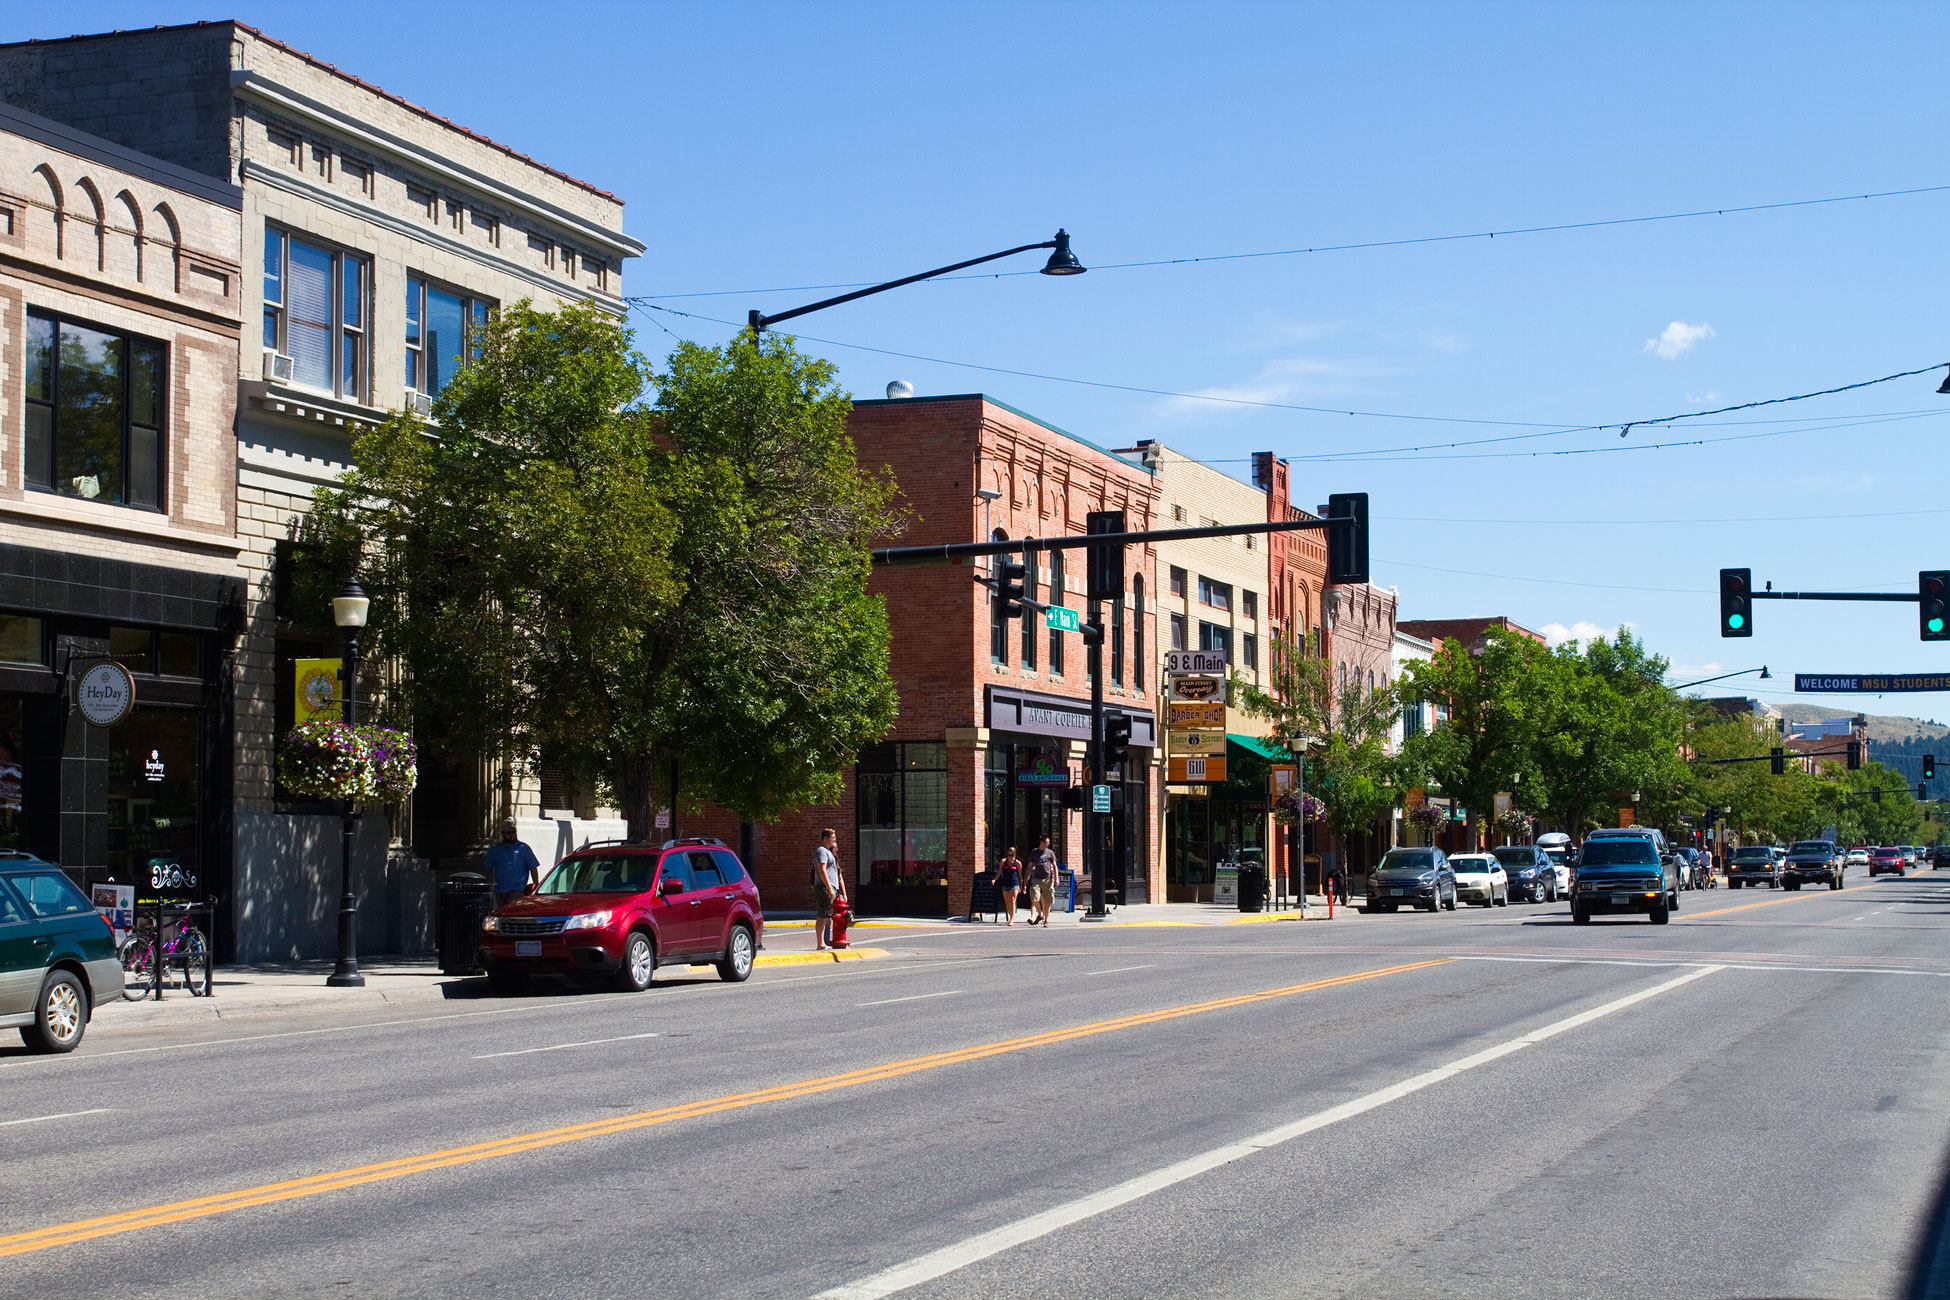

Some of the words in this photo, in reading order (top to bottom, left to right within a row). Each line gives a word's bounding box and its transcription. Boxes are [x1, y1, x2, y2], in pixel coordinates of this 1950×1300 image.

[1060, 610, 1070, 628] Main
[1170, 655, 1178, 670] 9
[1194, 654, 1223, 670] Main
[1800, 678, 1858, 689] WELCOME
[1862, 678, 1888, 689] MSU
[1893, 677, 1950, 689] STUDENTS
[87, 685, 122, 702] HeyDay
[1029, 708, 1052, 724] AVANT
[1055, 712, 1086, 729] COURIER
[1170, 707, 1200, 724] BARBER
[1204, 706, 1223, 723] SHOP
